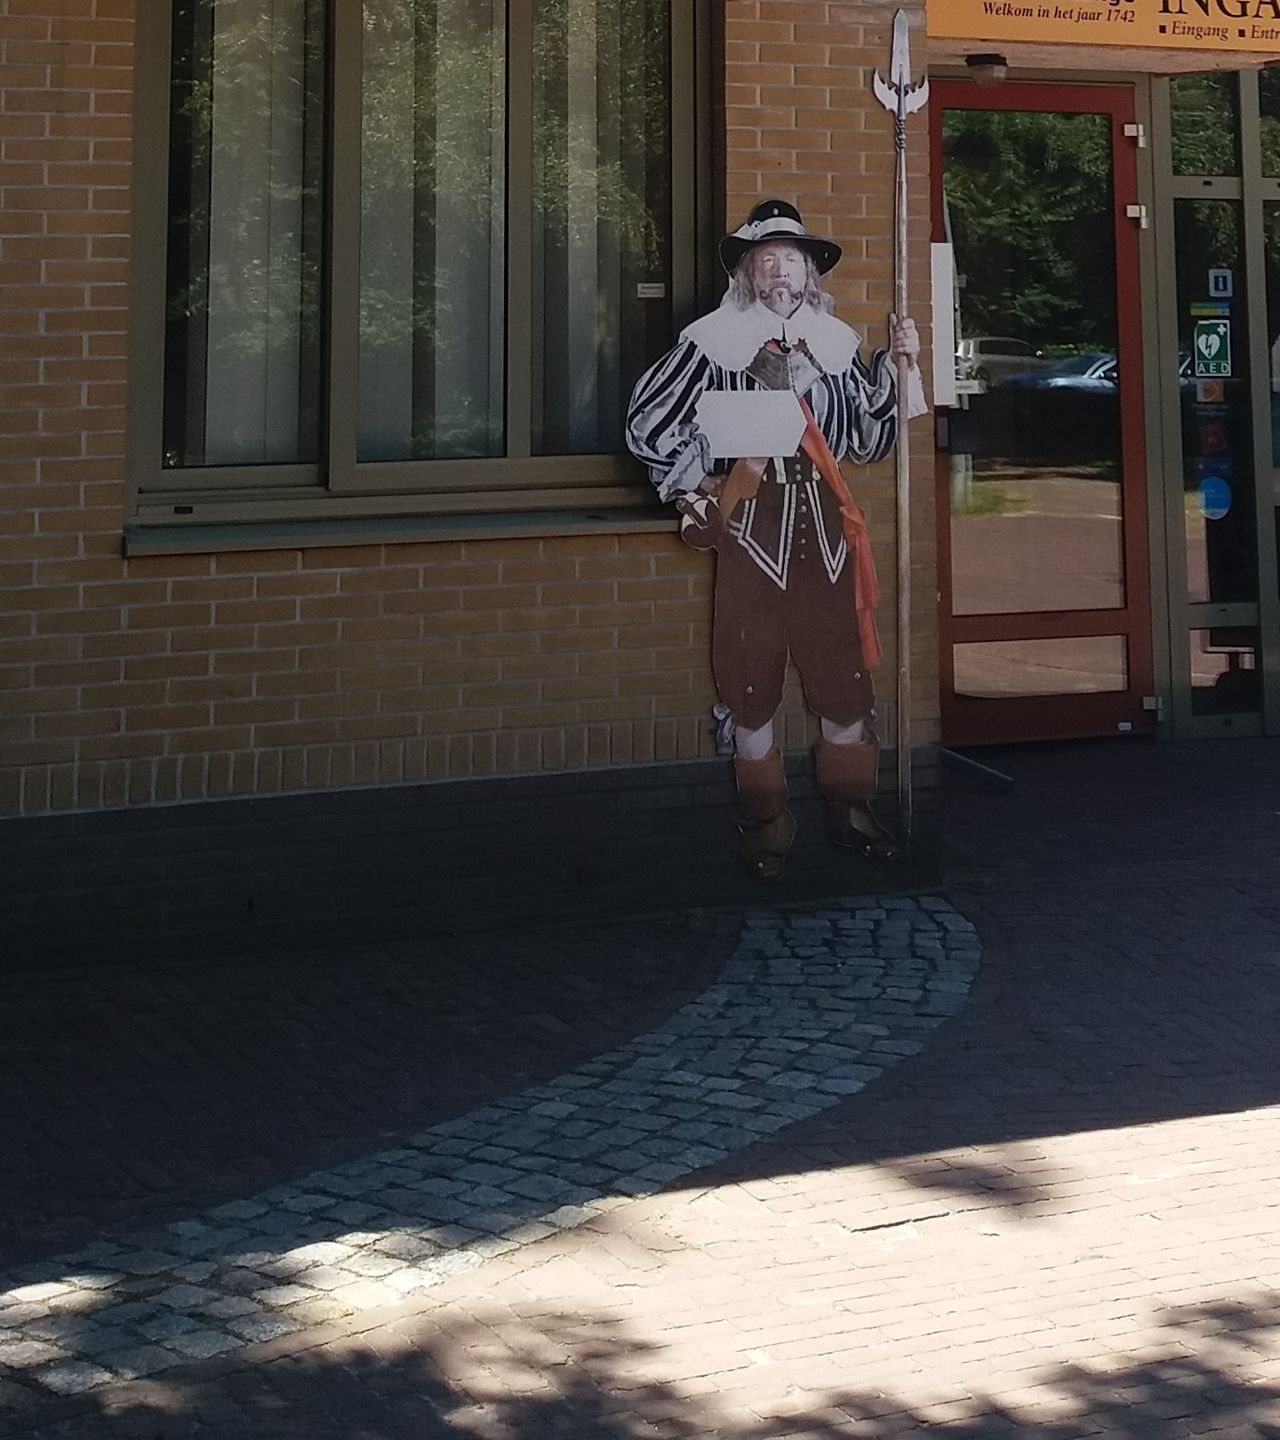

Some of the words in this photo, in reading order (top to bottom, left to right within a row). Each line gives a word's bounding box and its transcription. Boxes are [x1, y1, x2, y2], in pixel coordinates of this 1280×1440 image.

[983, 2, 1034, 17] Welkom
[1037, 3, 1050, 18] in
[1054, 6, 1073, 20] het
[1074, 7, 1103, 23] jaar
[1106, 8, 1135, 23] 1742
[1172, 20, 1229, 41] Eingang
[1198, 362, 1230, 373] AED
